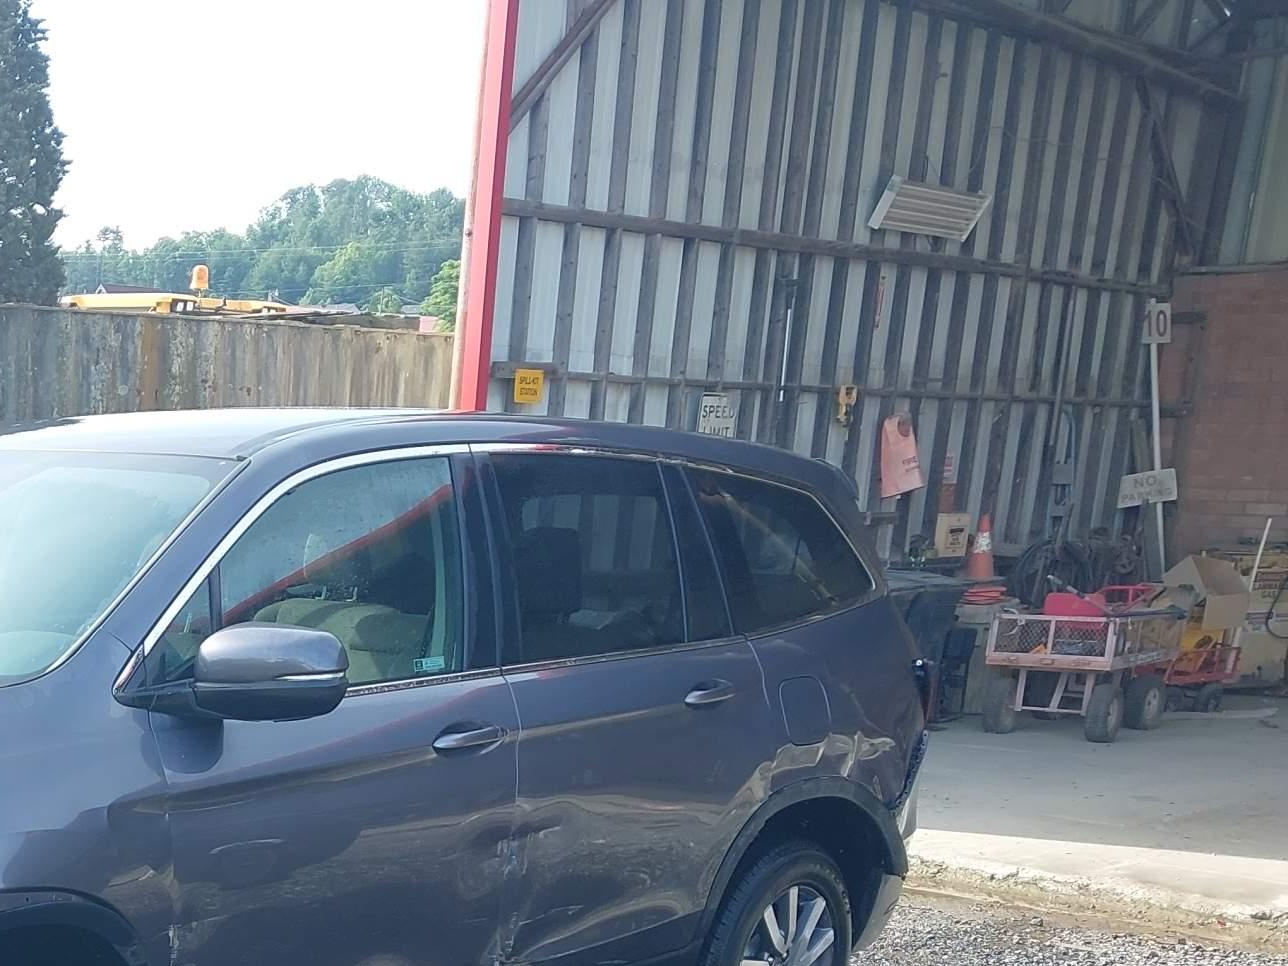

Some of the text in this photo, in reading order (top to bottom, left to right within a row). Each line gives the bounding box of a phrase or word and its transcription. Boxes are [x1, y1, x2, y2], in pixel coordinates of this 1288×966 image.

[1144, 310, 1167, 337] 10
[702, 404, 734, 419] SPEED
[1134, 475, 1157, 488] NO
